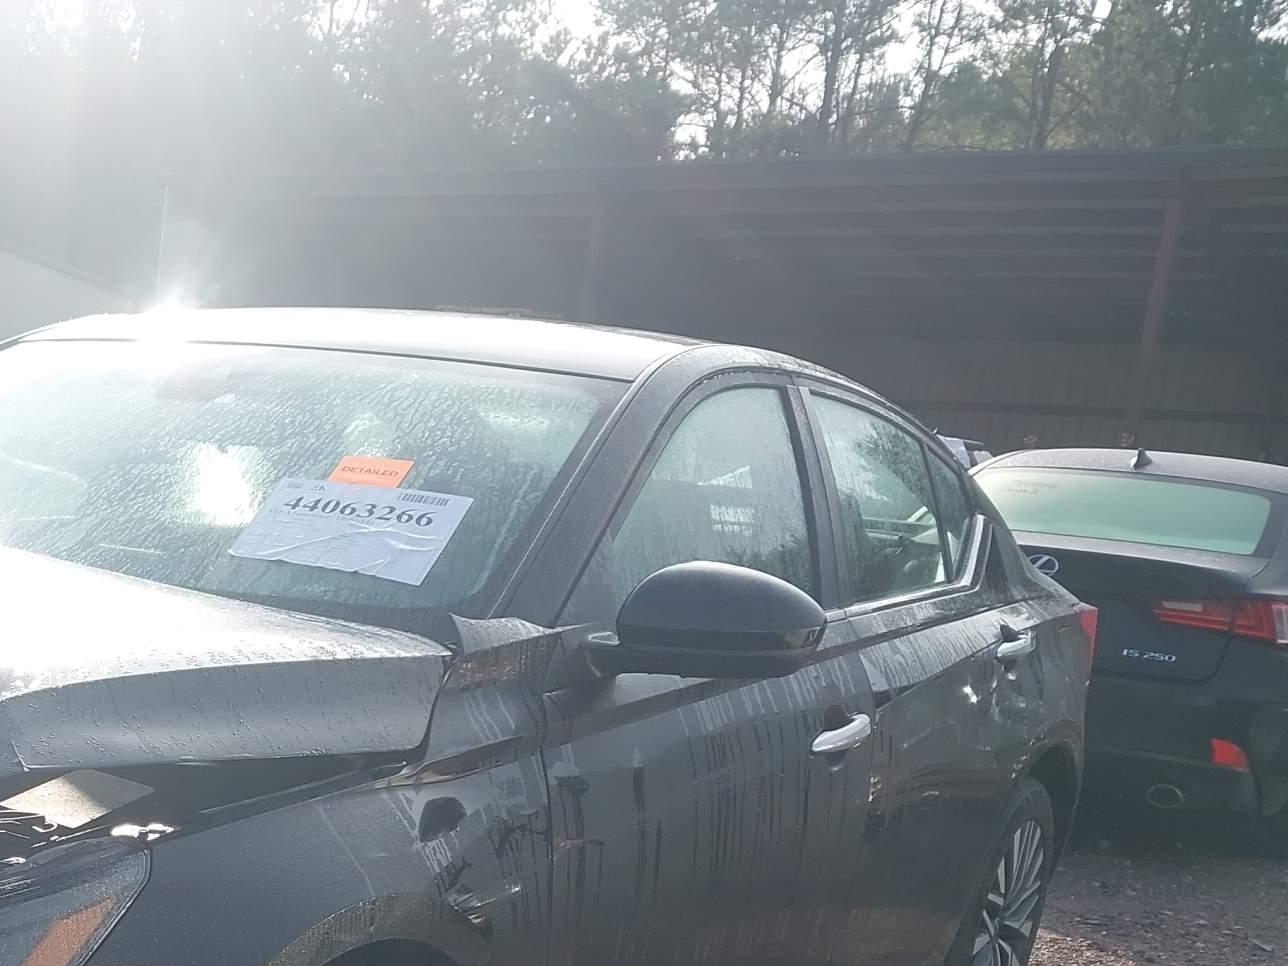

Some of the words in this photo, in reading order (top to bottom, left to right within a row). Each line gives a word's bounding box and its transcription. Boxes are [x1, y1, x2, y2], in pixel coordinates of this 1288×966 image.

[341, 466, 399, 477] DETAILED
[284, 496, 436, 527] 44063266
[1122, 648, 1140, 657] IS
[1143, 651, 1176, 662] 250
